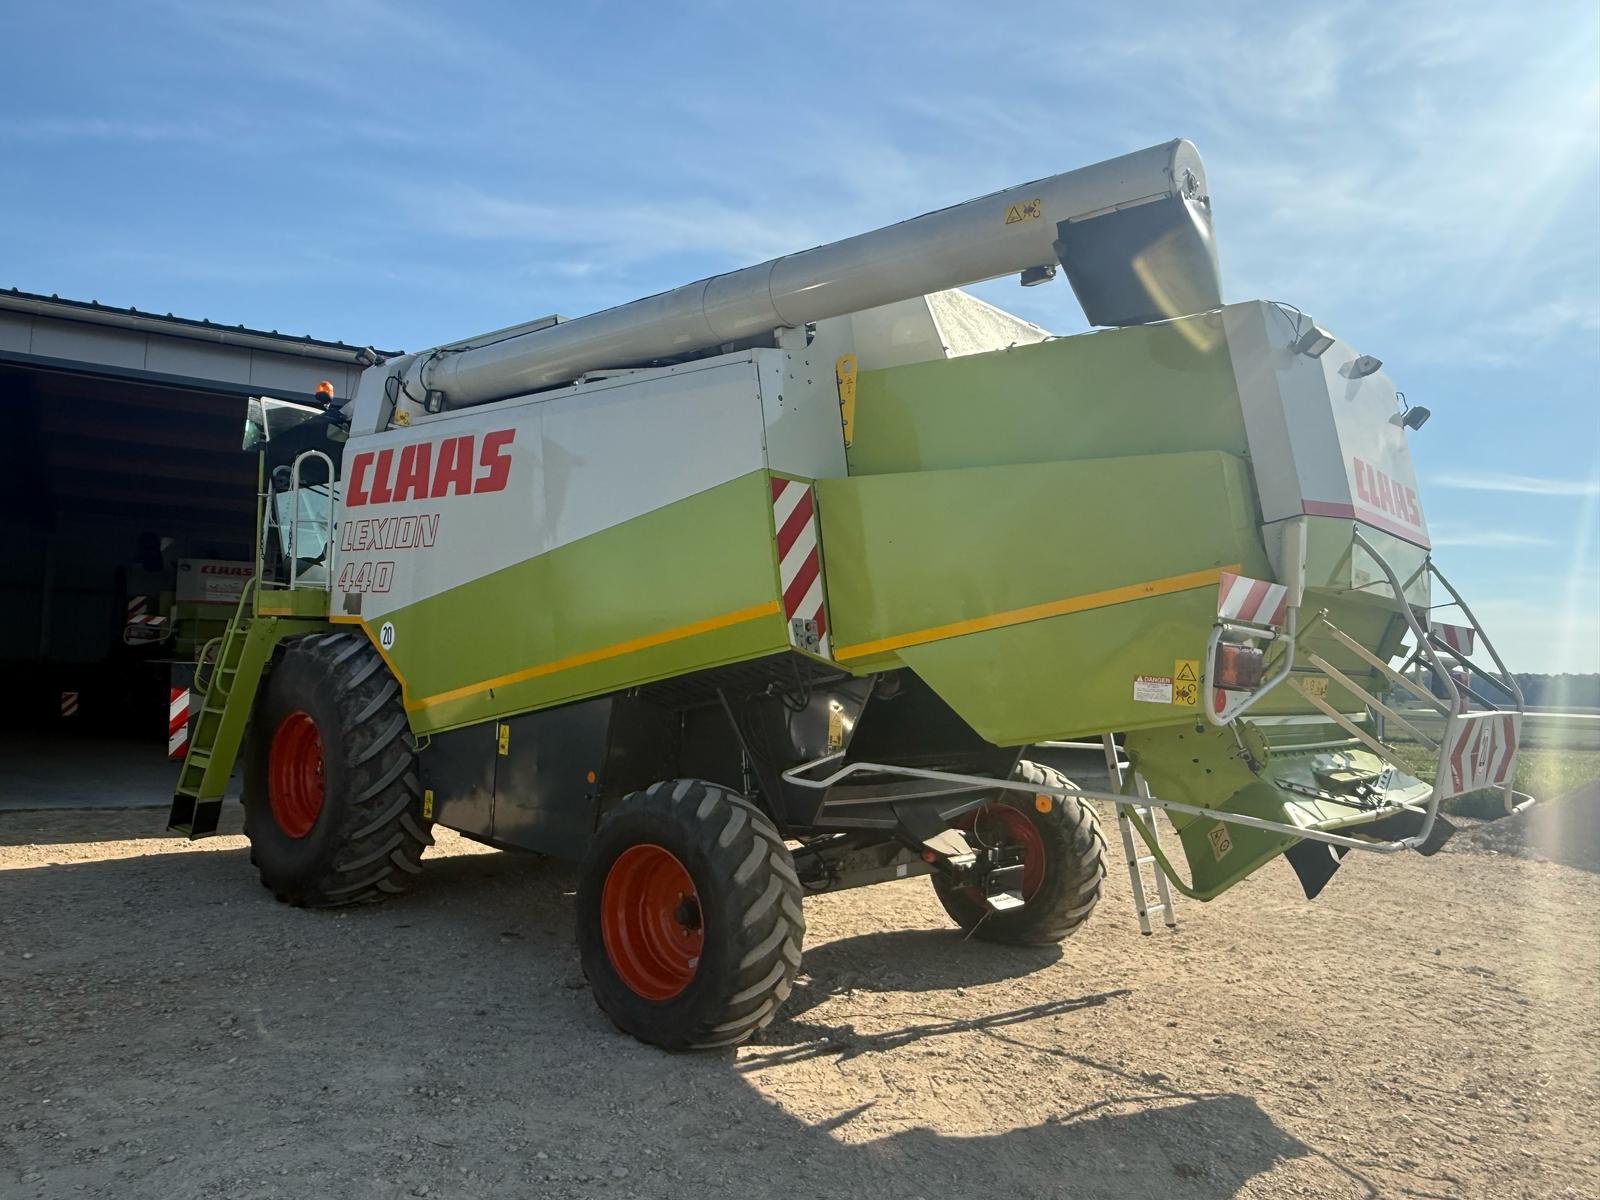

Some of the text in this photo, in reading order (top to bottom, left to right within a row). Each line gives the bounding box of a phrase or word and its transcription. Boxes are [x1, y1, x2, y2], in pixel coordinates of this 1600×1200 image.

[346, 428, 516, 507] CLAAS
[1353, 456, 1421, 528] CLAAS
[340, 513, 440, 552] LEXION
[201, 565, 252, 576] CLAAS
[338, 561, 395, 593] 440
[383, 626, 392, 645] 20
